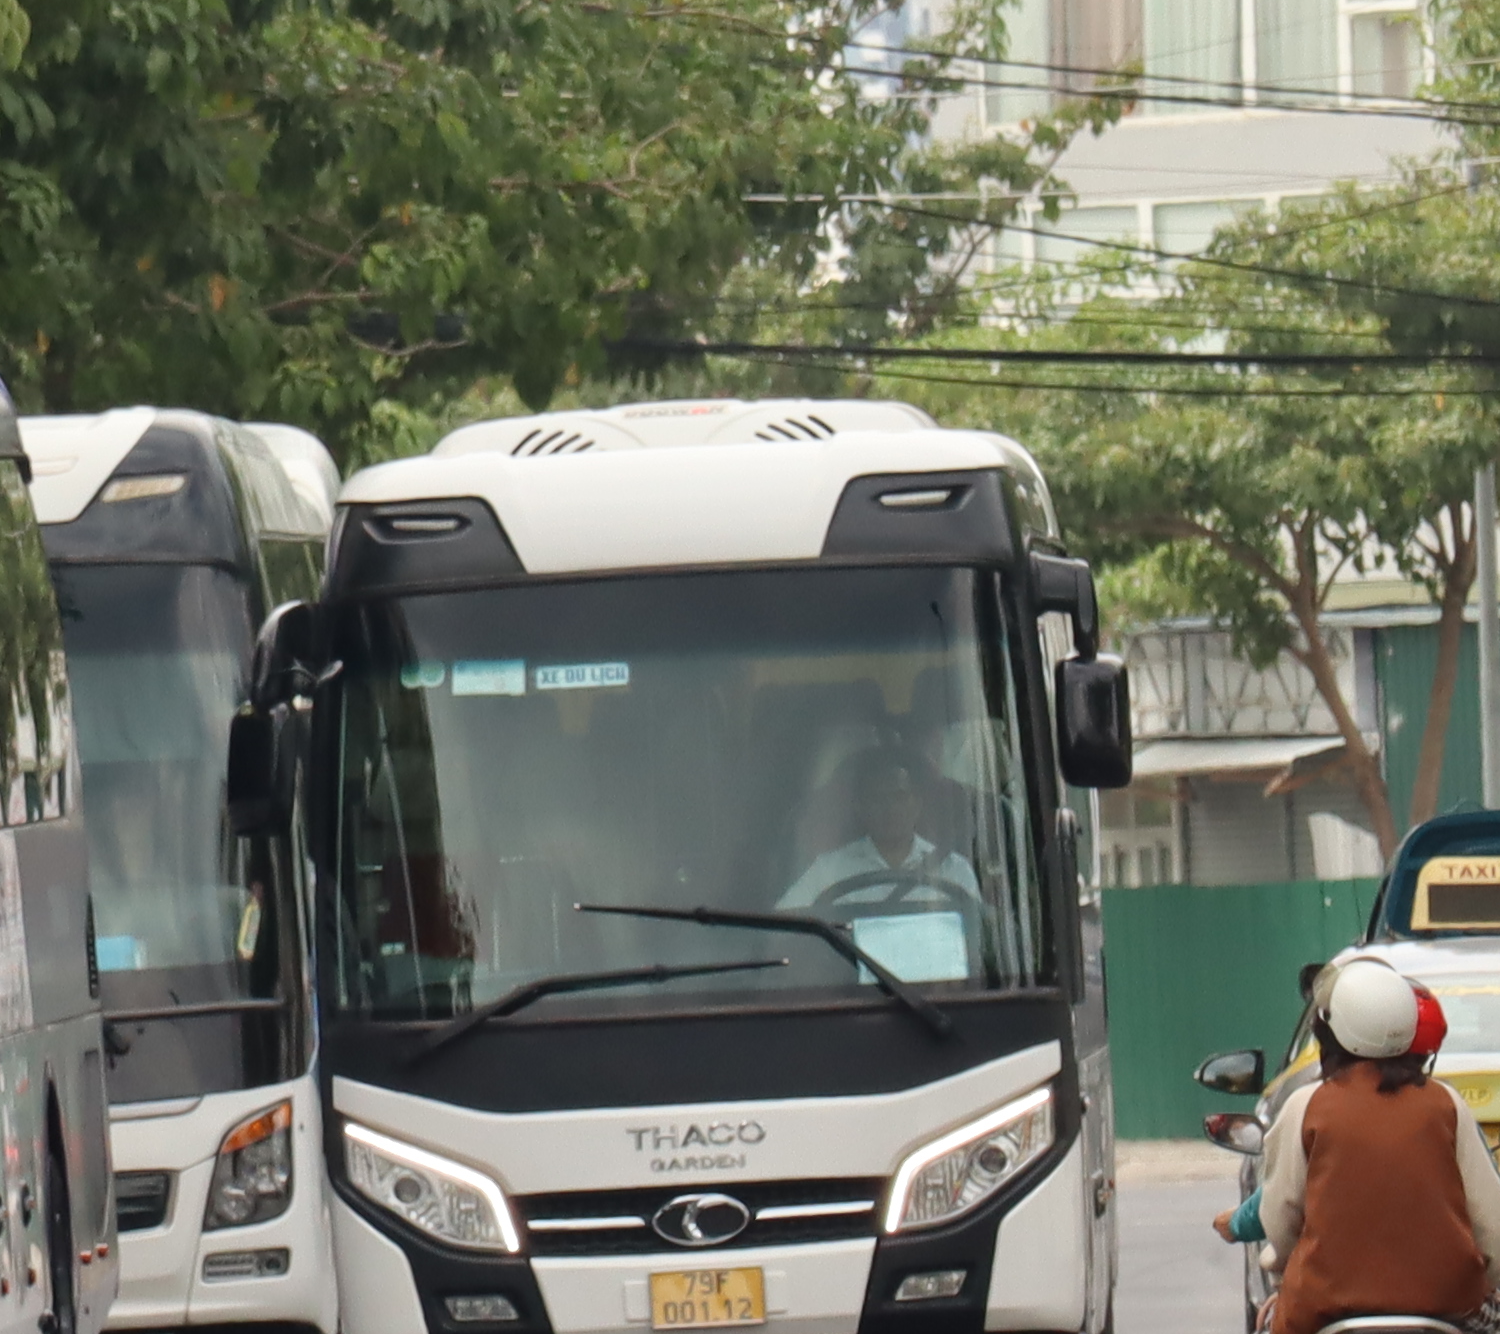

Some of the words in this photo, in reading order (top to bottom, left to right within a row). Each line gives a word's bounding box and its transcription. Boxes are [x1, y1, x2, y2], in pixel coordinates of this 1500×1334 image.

[1447, 864, 1496, 880] TAXI
[626, 1120, 766, 1151] THACO
[651, 1154, 747, 1172] GARDEN
[664, 1298, 753, 1323] 001.12
